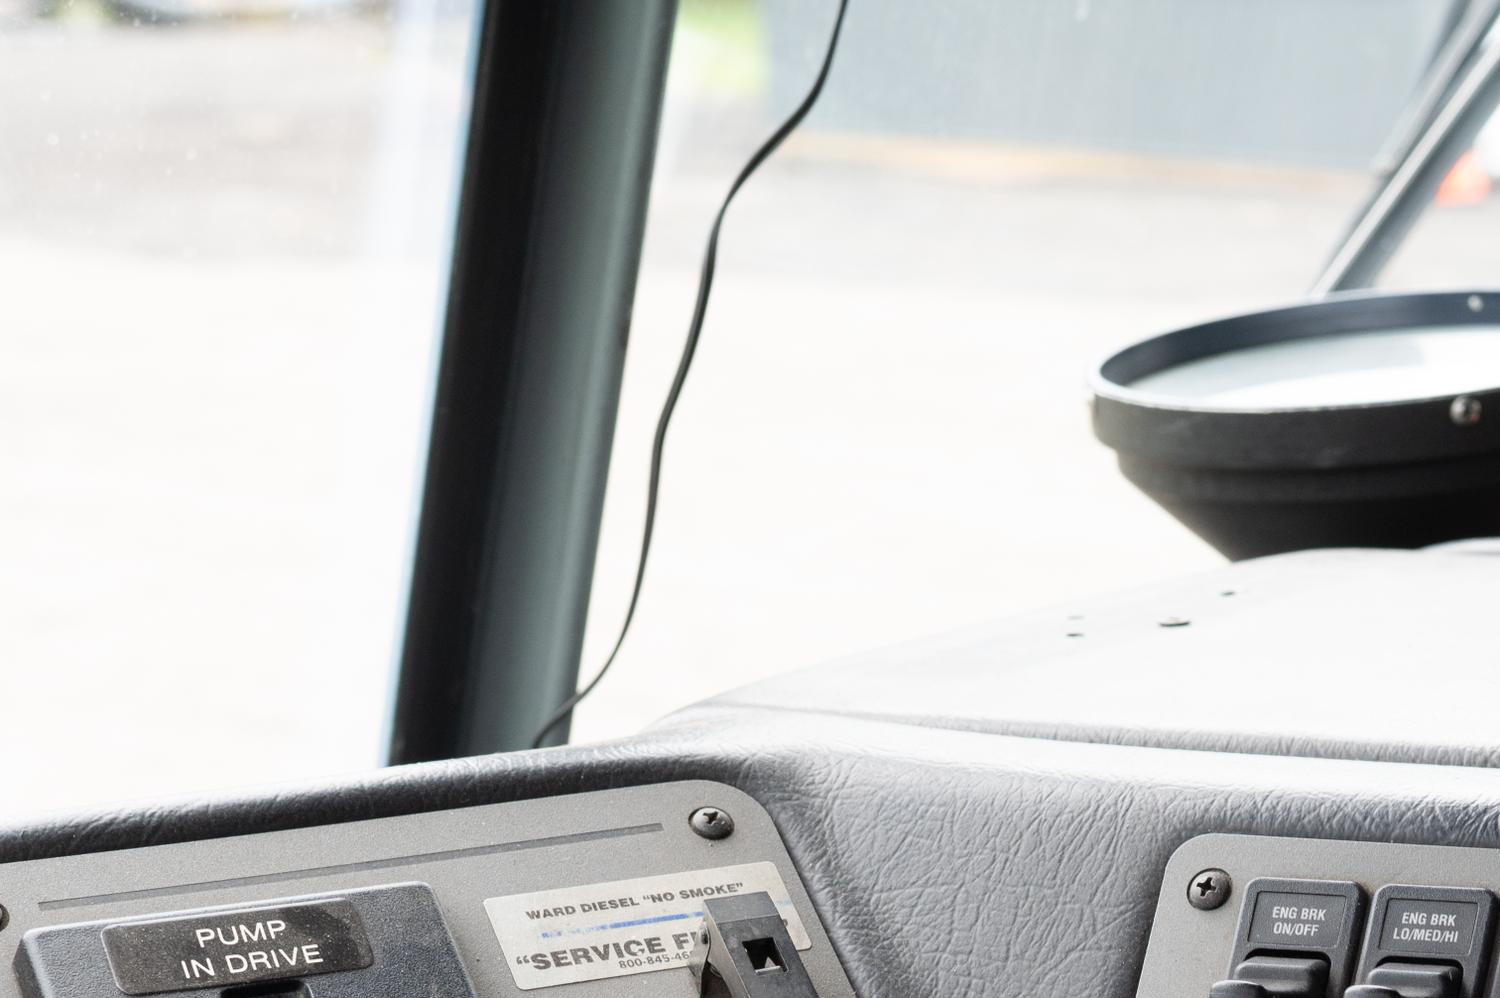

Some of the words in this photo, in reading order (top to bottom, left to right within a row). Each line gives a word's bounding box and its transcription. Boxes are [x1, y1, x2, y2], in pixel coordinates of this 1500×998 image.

[525, 905, 576, 921] WARD
[581, 897, 640, 914] DIESEL
[1272, 907, 1298, 919] ENG
[1300, 908, 1327, 921] BRK
[1401, 912, 1427, 926] ENG
[1430, 914, 1457, 927] BRK
[195, 919, 287, 948] PUMP
[1273, 922, 1320, 937] ON/OFF
[1392, 928, 1459, 943] LO/MED/HI
[180, 958, 216, 979] IN
[224, 943, 325, 975] DRIVE
[618, 950, 695, 970] 800-845-46
